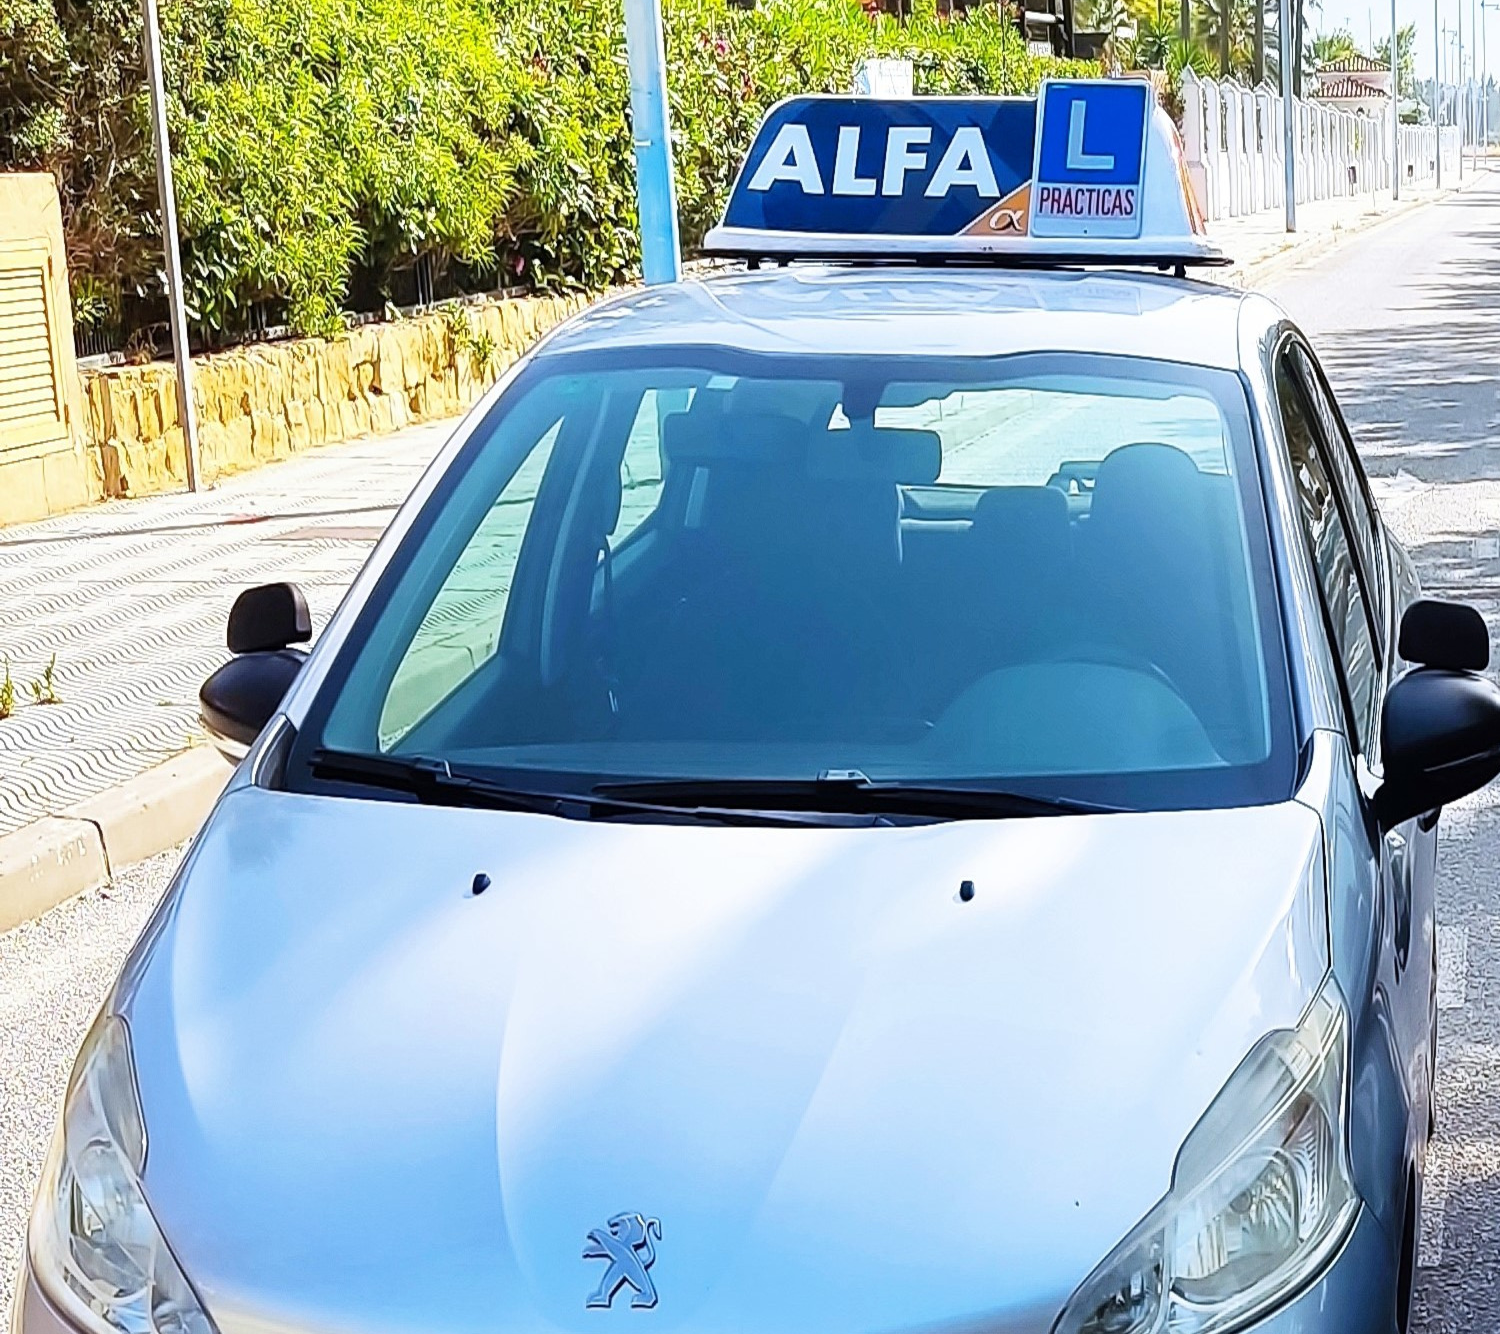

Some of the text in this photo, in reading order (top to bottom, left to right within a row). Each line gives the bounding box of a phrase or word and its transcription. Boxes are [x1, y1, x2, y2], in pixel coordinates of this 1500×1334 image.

[747, 124, 1001, 198] ALFA
[1066, 99, 1115, 170] L
[1038, 186, 1135, 217] PRACTICAS
